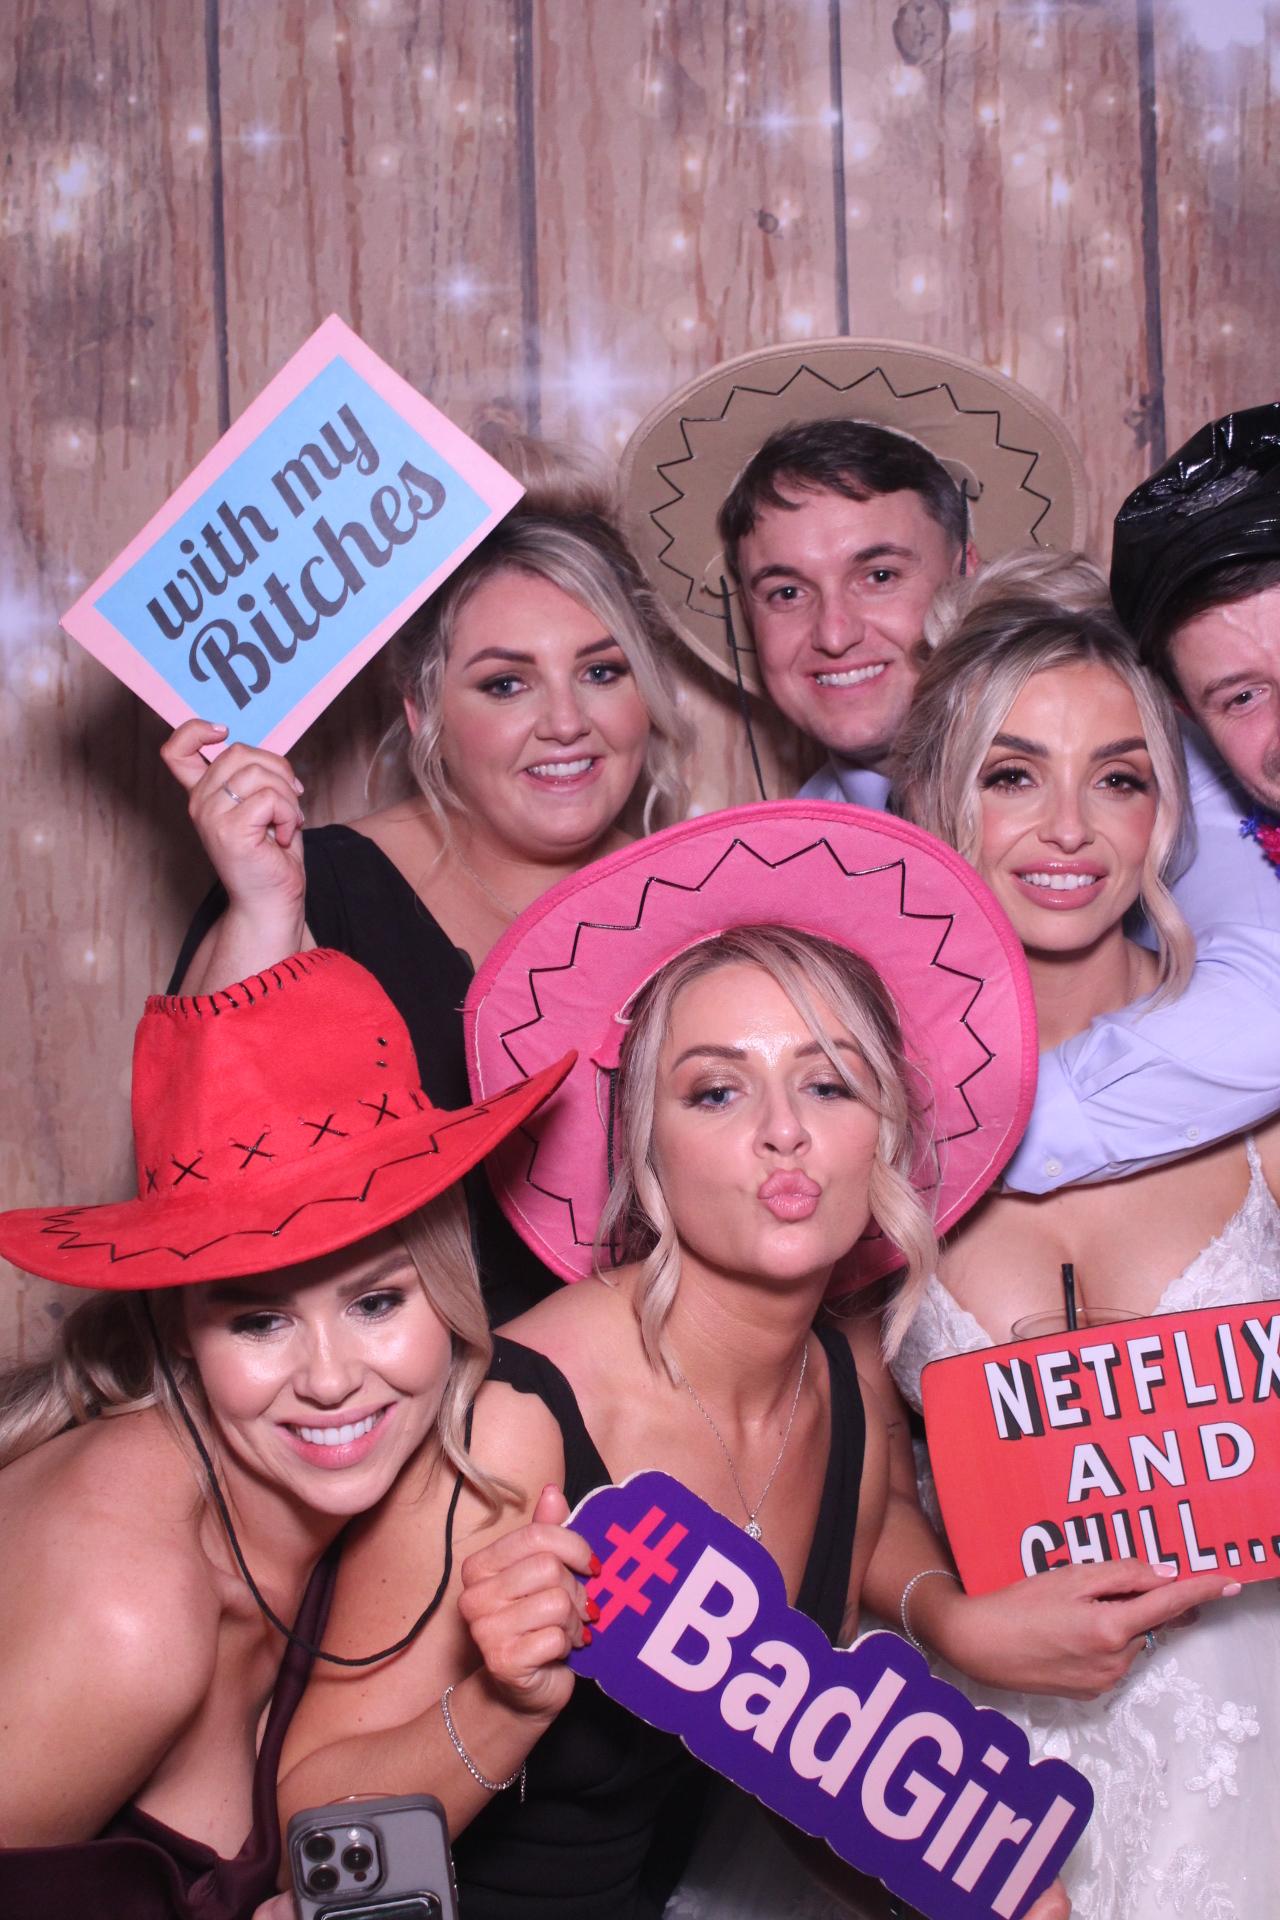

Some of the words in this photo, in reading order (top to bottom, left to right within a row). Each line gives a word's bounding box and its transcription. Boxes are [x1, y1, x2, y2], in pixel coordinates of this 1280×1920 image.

[145, 499, 279, 640] with
[270, 403, 380, 518] my
[188, 460, 446, 710] Bitches
[983, 1316, 1280, 1440] NETFLIX
[1067, 1421, 1256, 1503] AND
[585, 1506, 1077, 1920] #BadGirl
